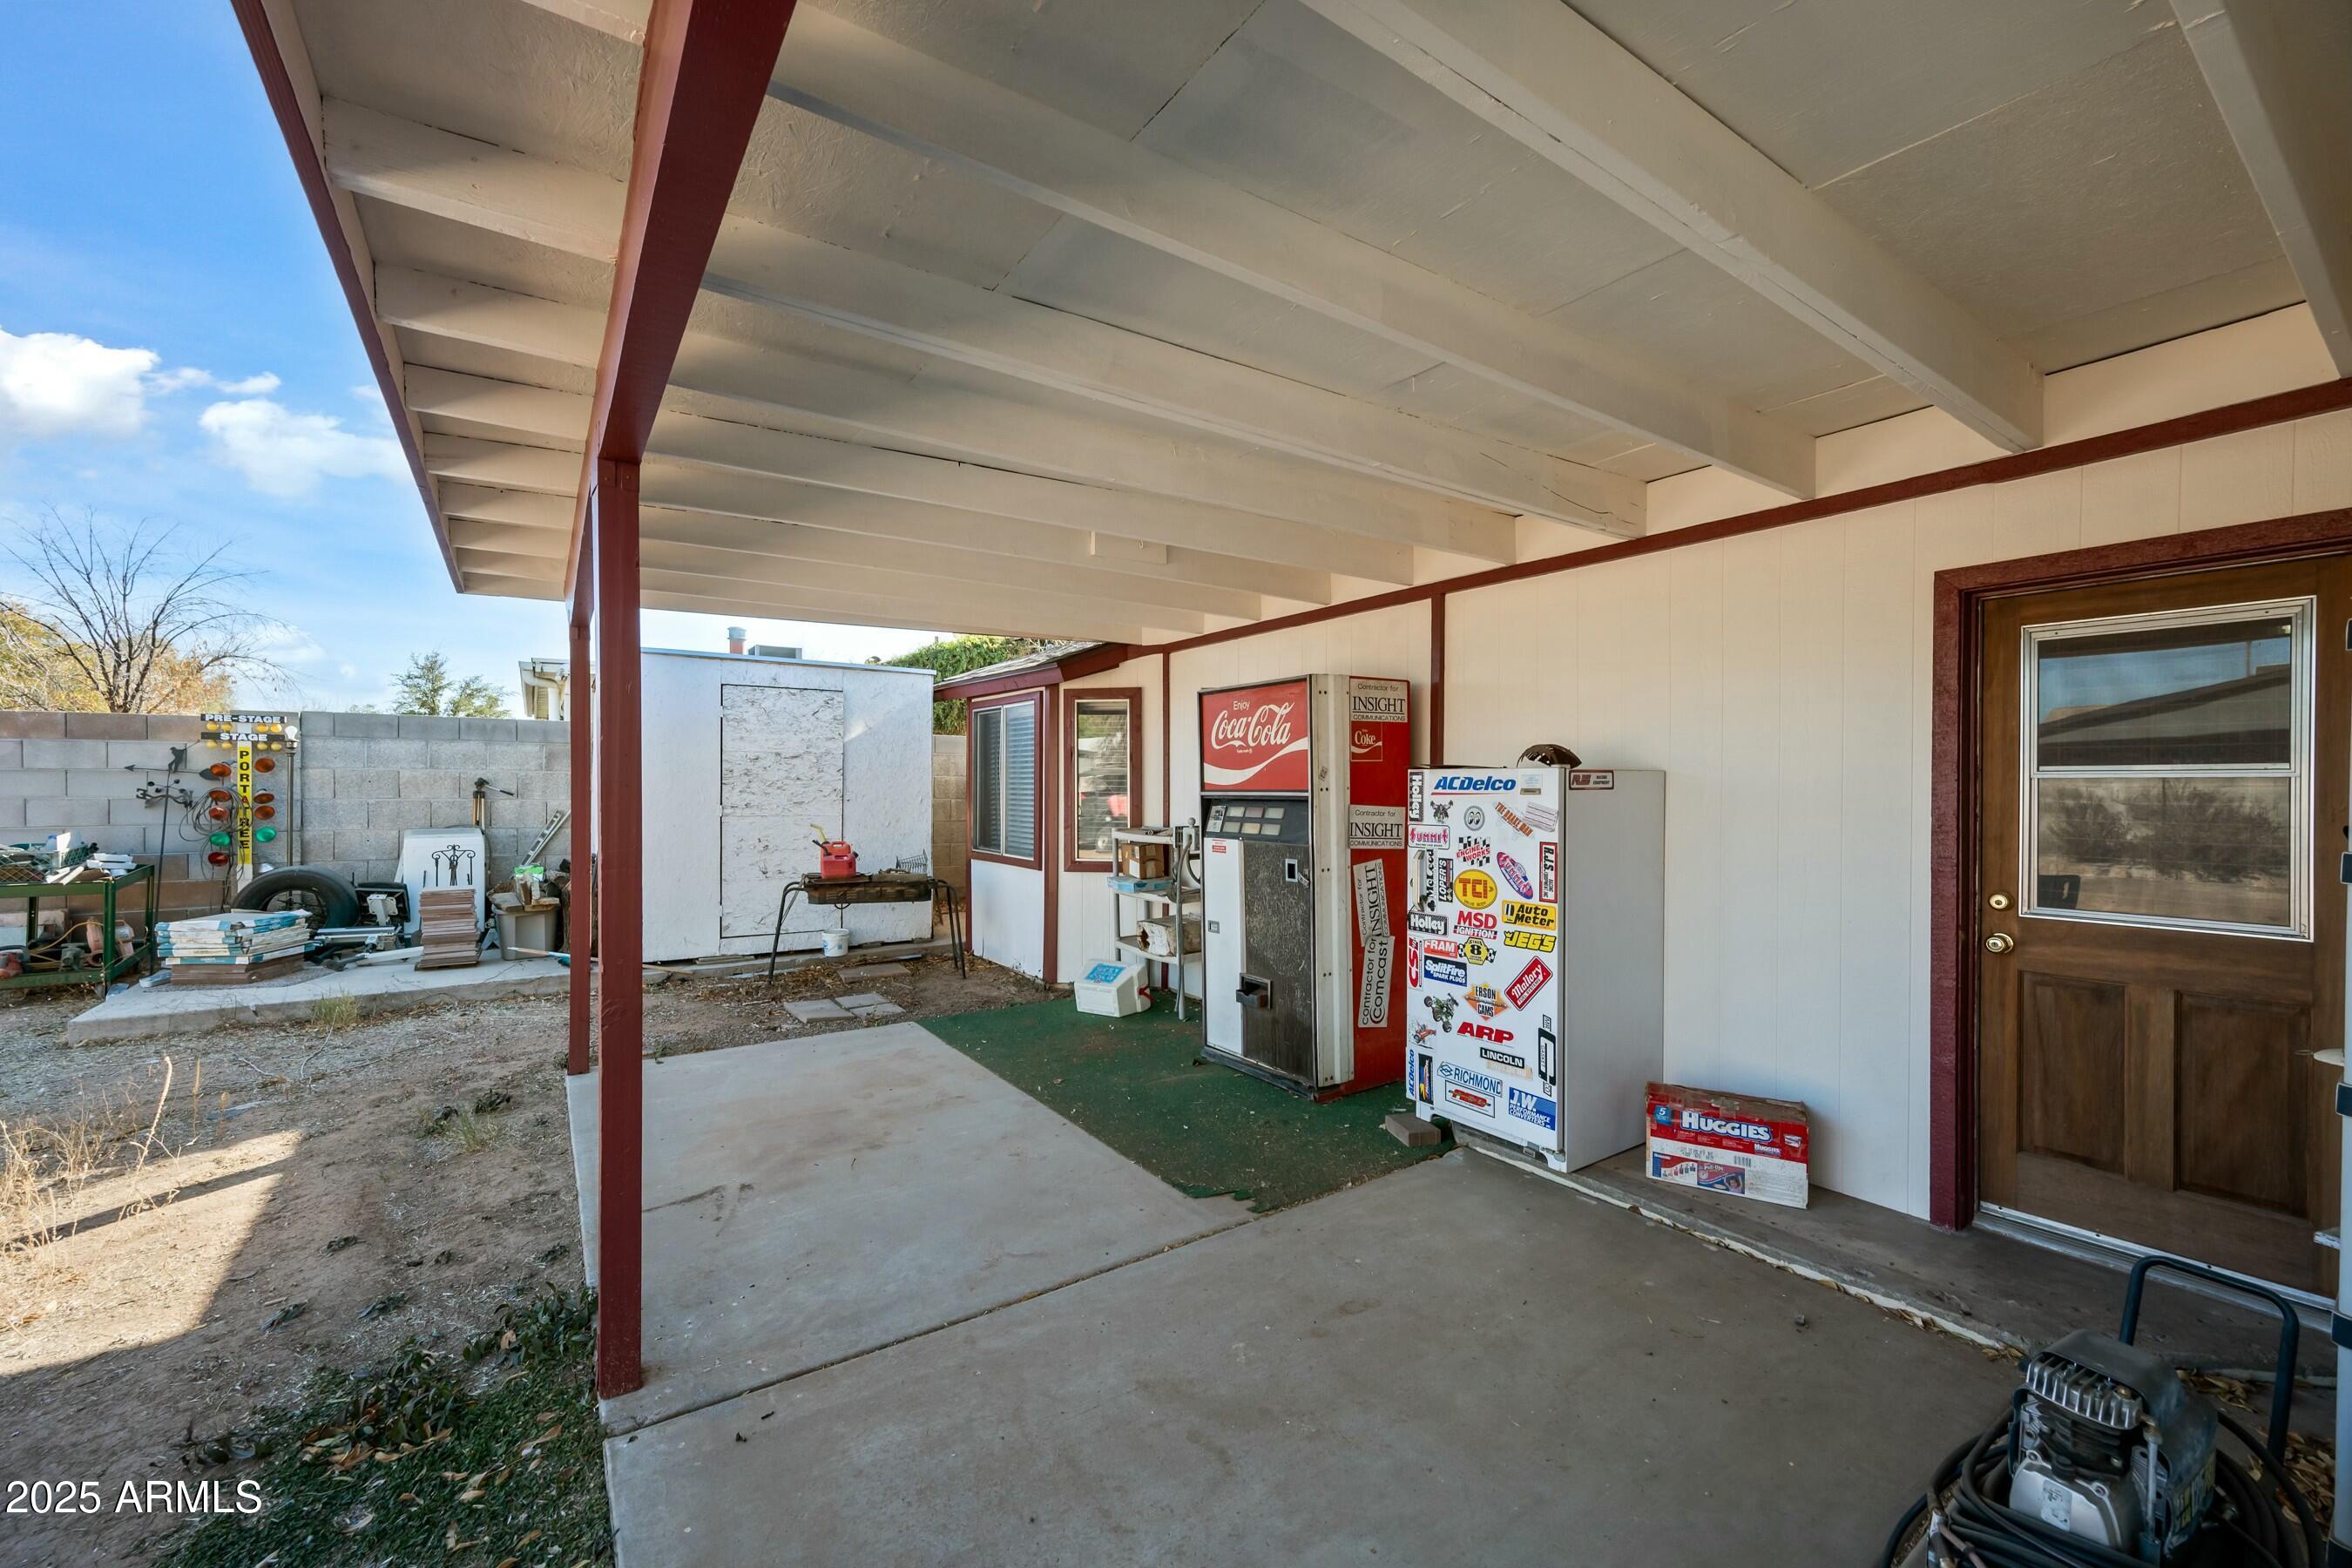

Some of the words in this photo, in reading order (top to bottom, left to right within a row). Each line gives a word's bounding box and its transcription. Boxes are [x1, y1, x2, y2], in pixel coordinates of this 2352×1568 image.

[1233, 700, 1250, 711] Enjoy
[1353, 696, 1406, 713] INSIGHT
[205, 714, 280, 724] PRE-STAGE
[220, 733, 267, 741] STAGE
[1355, 730, 1376, 745] Coke
[1434, 776, 1516, 791] ACDelco
[1409, 774, 1423, 819] Holley
[1350, 822, 1402, 837] INSIGHT
[1456, 845, 1480, 858] ENGINE
[1466, 848, 1490, 862] WORKS
[1459, 877, 1488, 899] TCI
[1365, 865, 1382, 936] INSIGHT
[1377, 862, 1389, 936] COMMUNICATIONS
[1358, 892, 1367, 936] Contractor
[1517, 904, 1549, 916] Auto
[1410, 914, 1445, 934] Holley
[1457, 910, 1497, 929] MSD
[1514, 913, 1555, 927] Meter
[1456, 926, 1495, 938] IGNITION
[1368, 937, 1376, 956] for
[1424, 940, 1455, 952] FRAM
[1470, 944, 1481, 955] 8
[1504, 931, 1557, 953] JEG'S
[1425, 960, 1466, 977] SplitFire
[1433, 972, 1449, 981] SPARK
[1449, 975, 1466, 983] PLUGS
[1512, 964, 1543, 998] Mallory
[1362, 957, 1375, 1025] contractor
[1475, 986, 1497, 1000] ERSON
[1477, 1004, 1494, 1017] CAMS
[1456, 1022, 1514, 1044] ARP
[1482, 1049, 1524, 1067] LINCOLN
[1454, 1068, 1501, 1095] RICHMOND
[1510, 1089, 1538, 1112] J.W.
[1510, 1104, 1551, 1123] PERFORMANCE
[1510, 1109, 1545, 1125] CONVERTERS
[1659, 1107, 1666, 1116] 5
[1682, 1111, 1771, 1140] HUGGIES
